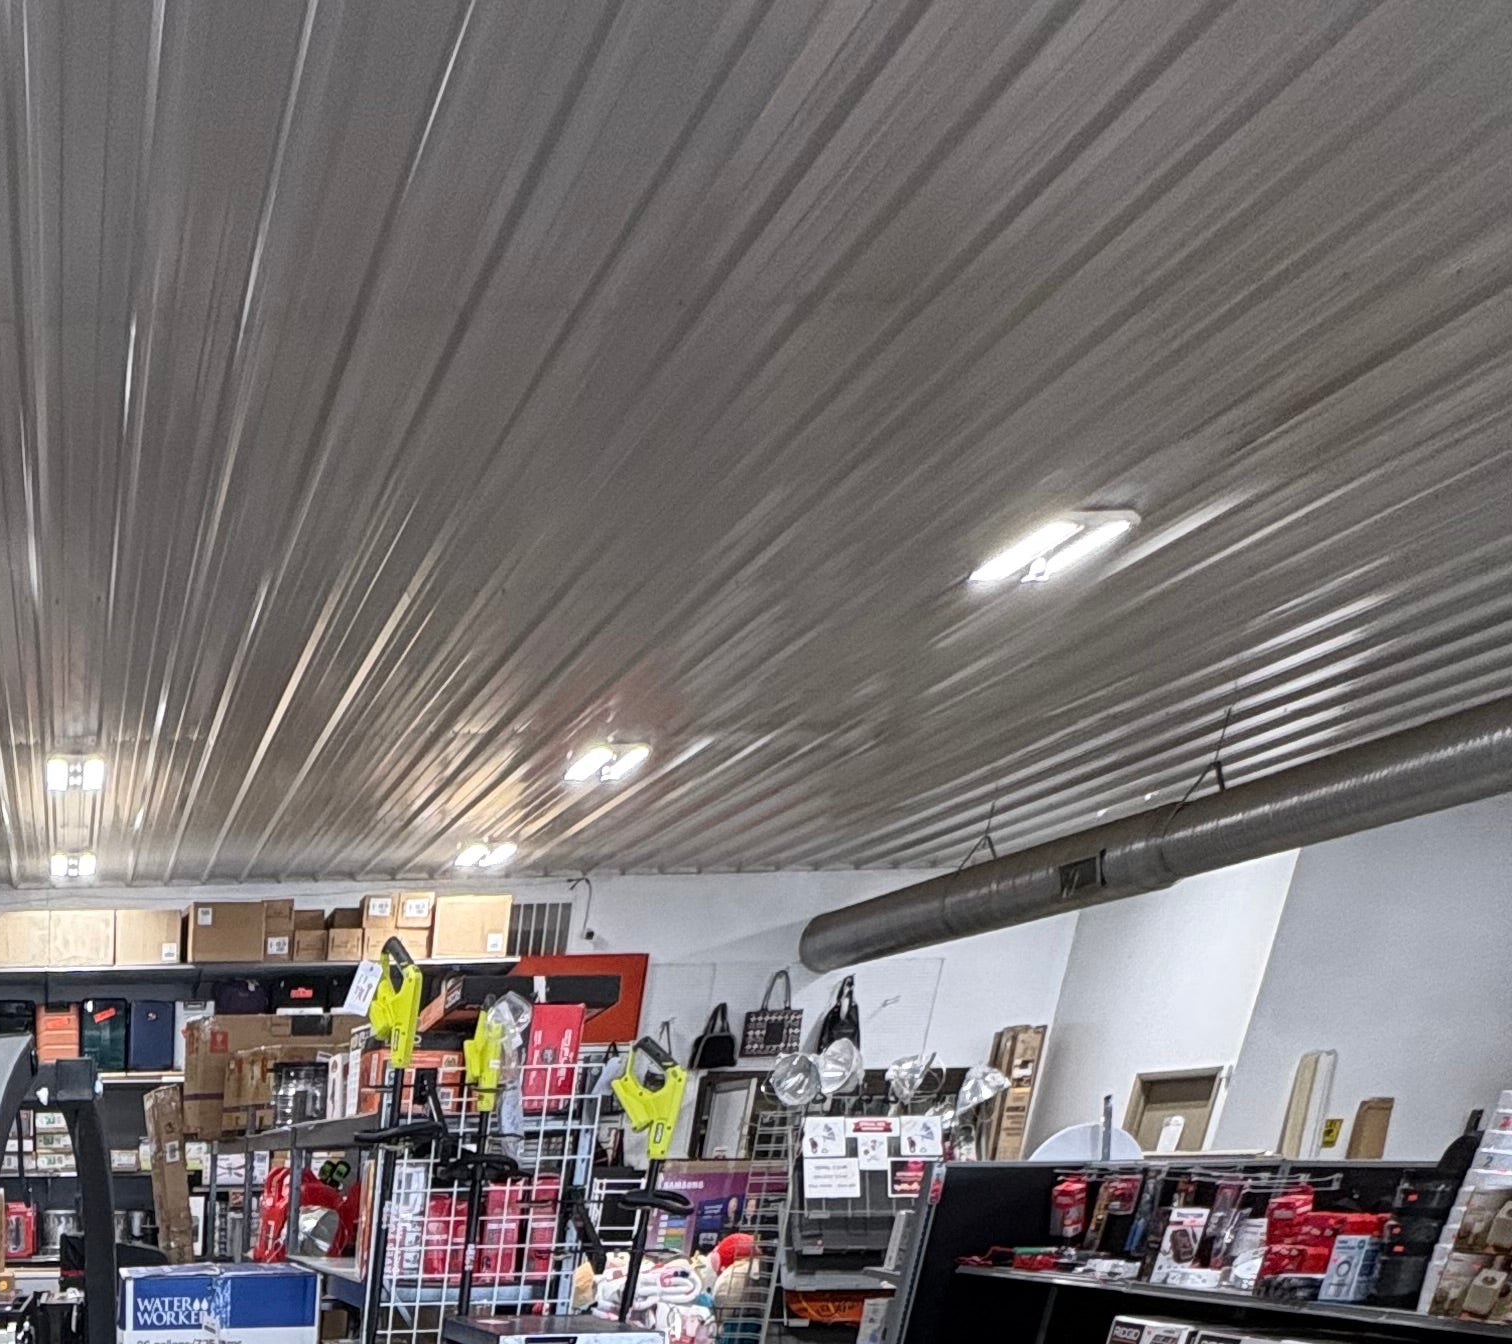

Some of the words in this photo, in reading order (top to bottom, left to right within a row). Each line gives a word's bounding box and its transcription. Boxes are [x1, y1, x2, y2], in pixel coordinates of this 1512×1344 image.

[663, 1181, 704, 1190] SAMSUNG
[137, 1297, 193, 1312] WATER
[137, 1311, 202, 1325] WORKE
[1113, 1325, 1141, 1339] RIDGID
